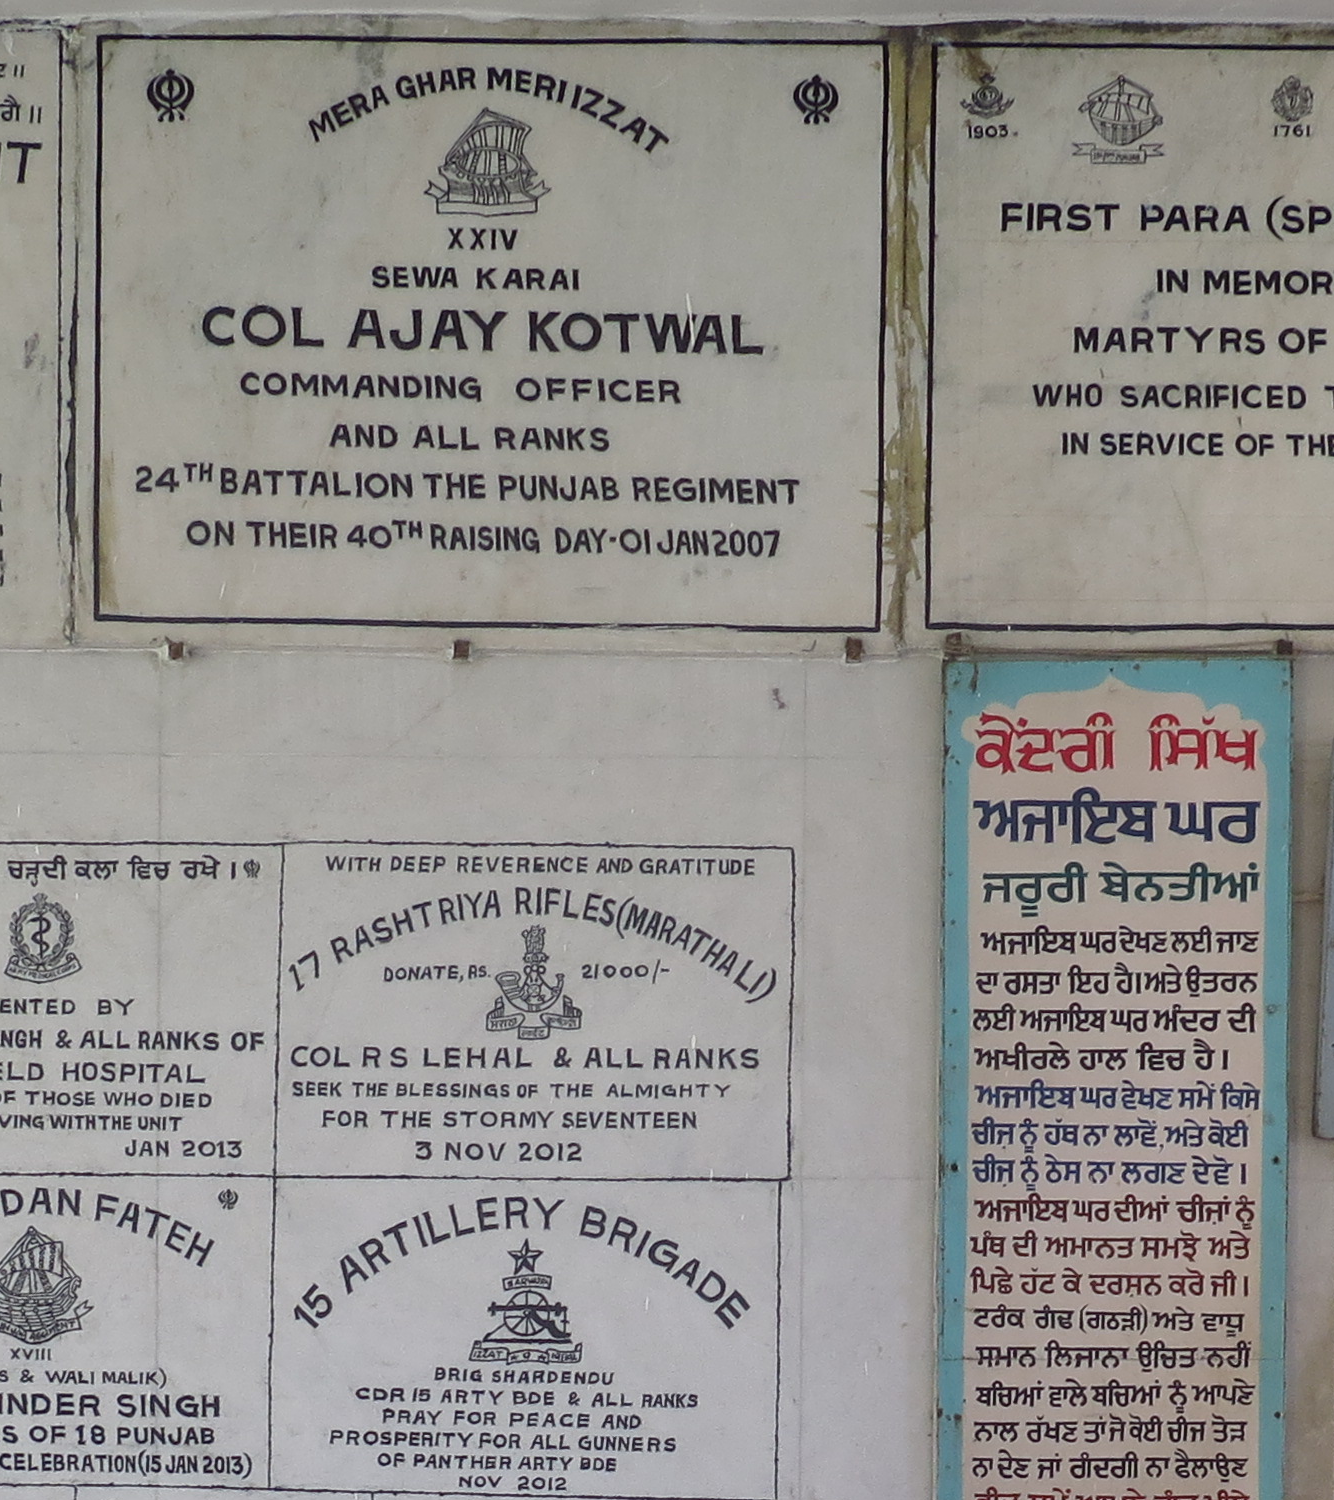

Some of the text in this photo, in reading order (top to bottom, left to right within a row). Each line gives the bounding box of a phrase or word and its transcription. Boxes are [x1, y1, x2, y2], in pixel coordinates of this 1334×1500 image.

[1274, 124, 1310, 137] 1761
[1001, 203, 1119, 232] FIRST
[1141, 205, 1250, 232] PARA
[448, 228, 517, 250] XXIV
[202, 305, 764, 355] COL AJAY KOTWAL
[1033, 383, 1102, 407] WHO
[1120, 384, 1306, 409] SACRIFICED
[221, 468, 413, 498] BATTALION
[423, 473, 485, 499] THE
[499, 475, 619, 501] PUNJAB
[632, 477, 800, 504] REGIMENT
[326, 856, 754, 876] WITH DEEP REVERENCE AND GRATITUDE
[63, 1062, 205, 1083] HOSPITAL
[25, 1091, 95, 1106] THOSE
[104, 1092, 153, 1106] WHO
[160, 1093, 212, 1108] DIED
[322, 1110, 696, 1129] FOR THE STORMY SEVENTEEN
[94, 1193, 215, 1267] FATEH
[293, 1196, 751, 1330] 15 ARTILLERY BRIGADE
[11, 1348, 51, 1360] XVIII
[435, 1367, 614, 1385] BRIG SHARDENDU
[117, 1394, 220, 1418] SINGH
[378, 1453, 616, 1472] OF PANTHER ARTY BDE
